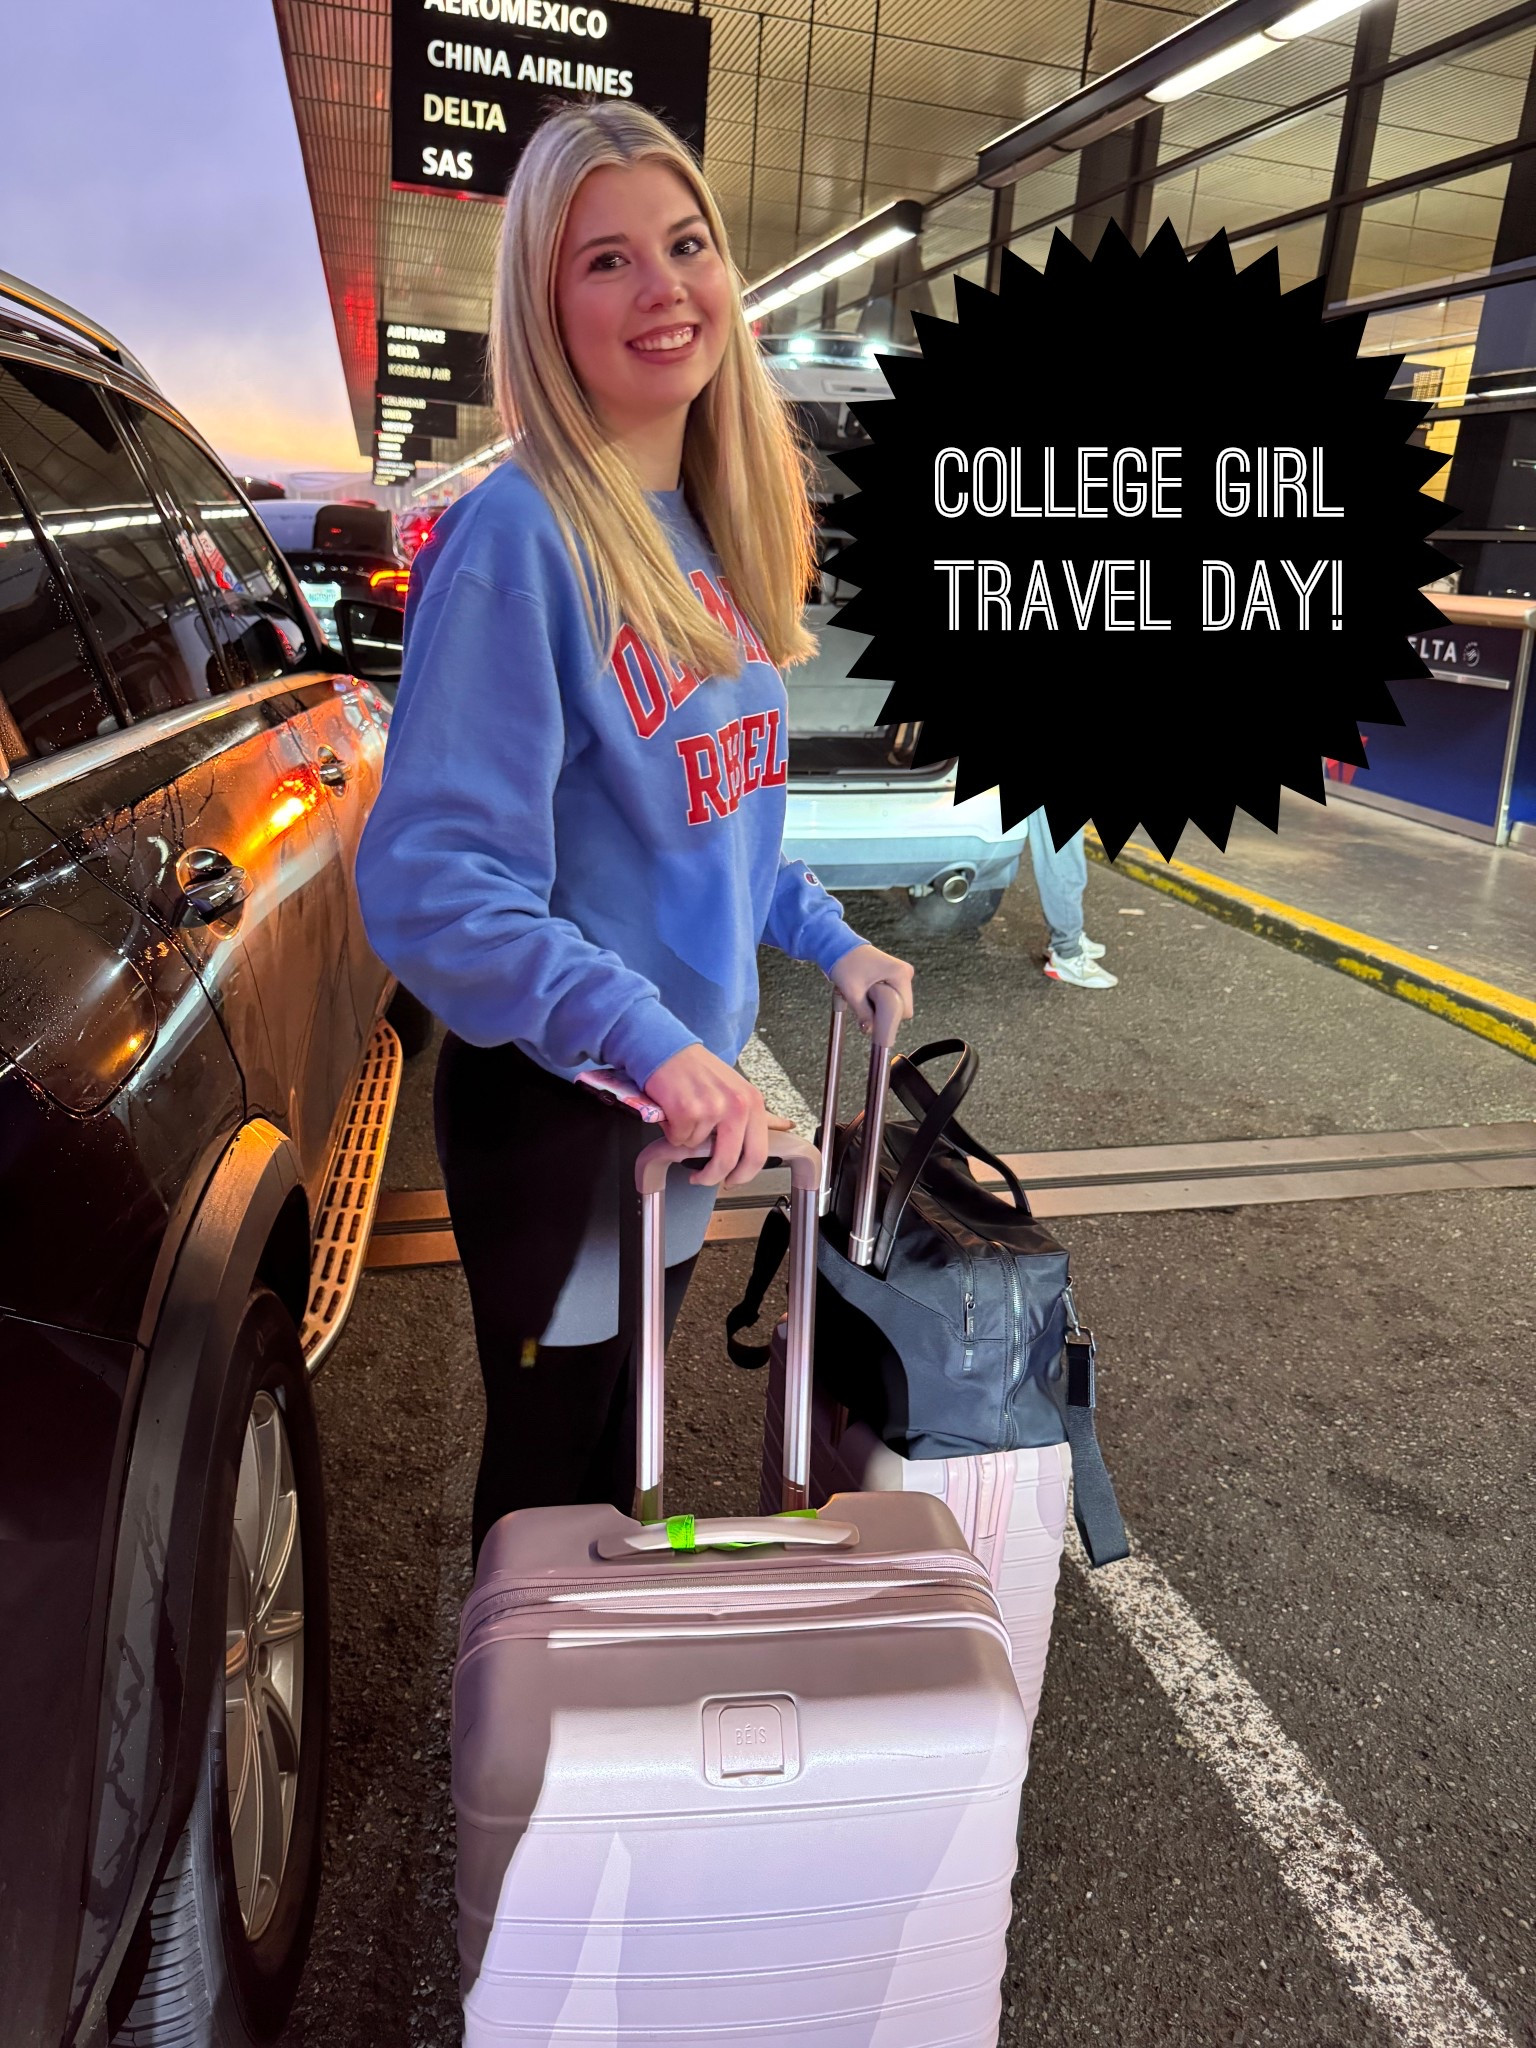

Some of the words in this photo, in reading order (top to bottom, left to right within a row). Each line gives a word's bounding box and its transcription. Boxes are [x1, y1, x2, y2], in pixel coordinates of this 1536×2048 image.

[427, 39, 512, 79] CHINA
[518, 54, 634, 98] AIRLINES
[423, 93, 507, 134] DELTA
[422, 146, 473, 180] SAS
[386, 324, 406, 340] AIR
[406, 326, 447, 345] FRANCE
[387, 343, 421, 360] DELTA
[387, 362, 432, 380] KOREAN
[432, 366, 452, 382] AIR
[1407, 636, 1457, 663] LTA
[735, 1723, 767, 1746] BÉIS
